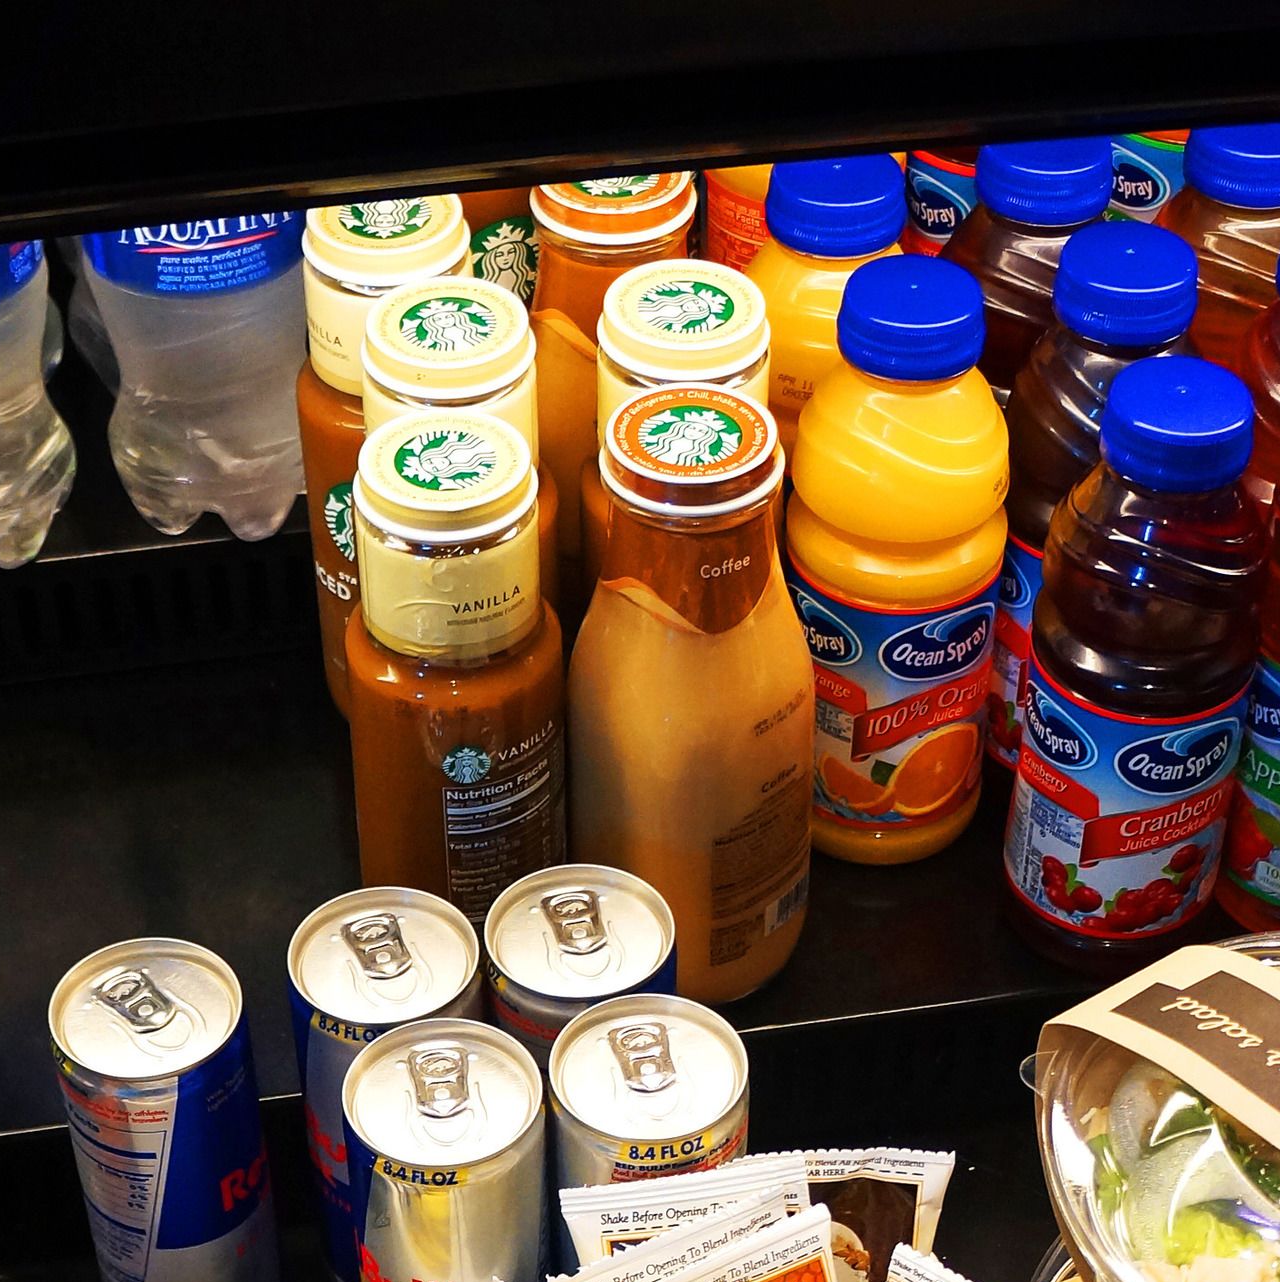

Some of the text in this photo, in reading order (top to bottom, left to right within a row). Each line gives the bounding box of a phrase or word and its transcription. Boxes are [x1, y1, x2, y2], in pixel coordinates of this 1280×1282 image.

[1118, 176, 1153, 200] Spray
[921, 204, 956, 229] Spray
[687, 390, 738, 409] Chill, shake,
[315, 560, 351, 600] ICED
[699, 552, 752, 582] Coffee
[451, 585, 522, 614] VANILLA
[810, 626, 845, 656] Spray
[892, 620, 987, 667] Ocean Spray
[866, 694, 929, 738] 100%
[928, 706, 963, 725] Juice
[1026, 692, 1080, 760] Ocean Spray
[498, 720, 554, 761] VANILLA
[1022, 752, 1068, 792] Cranberry
[1128, 735, 1228, 781] Ocean Spray
[446, 758, 549, 800] Nutrition Facts
[760, 761, 799, 795] Coffee
[1120, 789, 1223, 837] Cranberry
[1119, 836, 1160, 852] Juice
[319, 1015, 363, 1042] 8.4 FL
[1159, 994, 1266, 1050] salad
[629, 1136, 704, 1160] 8.4 FL OZ
[383, 1160, 458, 1188] 8.4 FL OZ
[600, 1203, 709, 1226] Shake Before Opening
[646, 1255, 688, 1280] Opening
[687, 1248, 701, 1262] To
[702, 1234, 729, 1254] Blend
[727, 1266, 742, 1280] To
[742, 1254, 771, 1277] Blend
[771, 1233, 821, 1263] Ingredients
